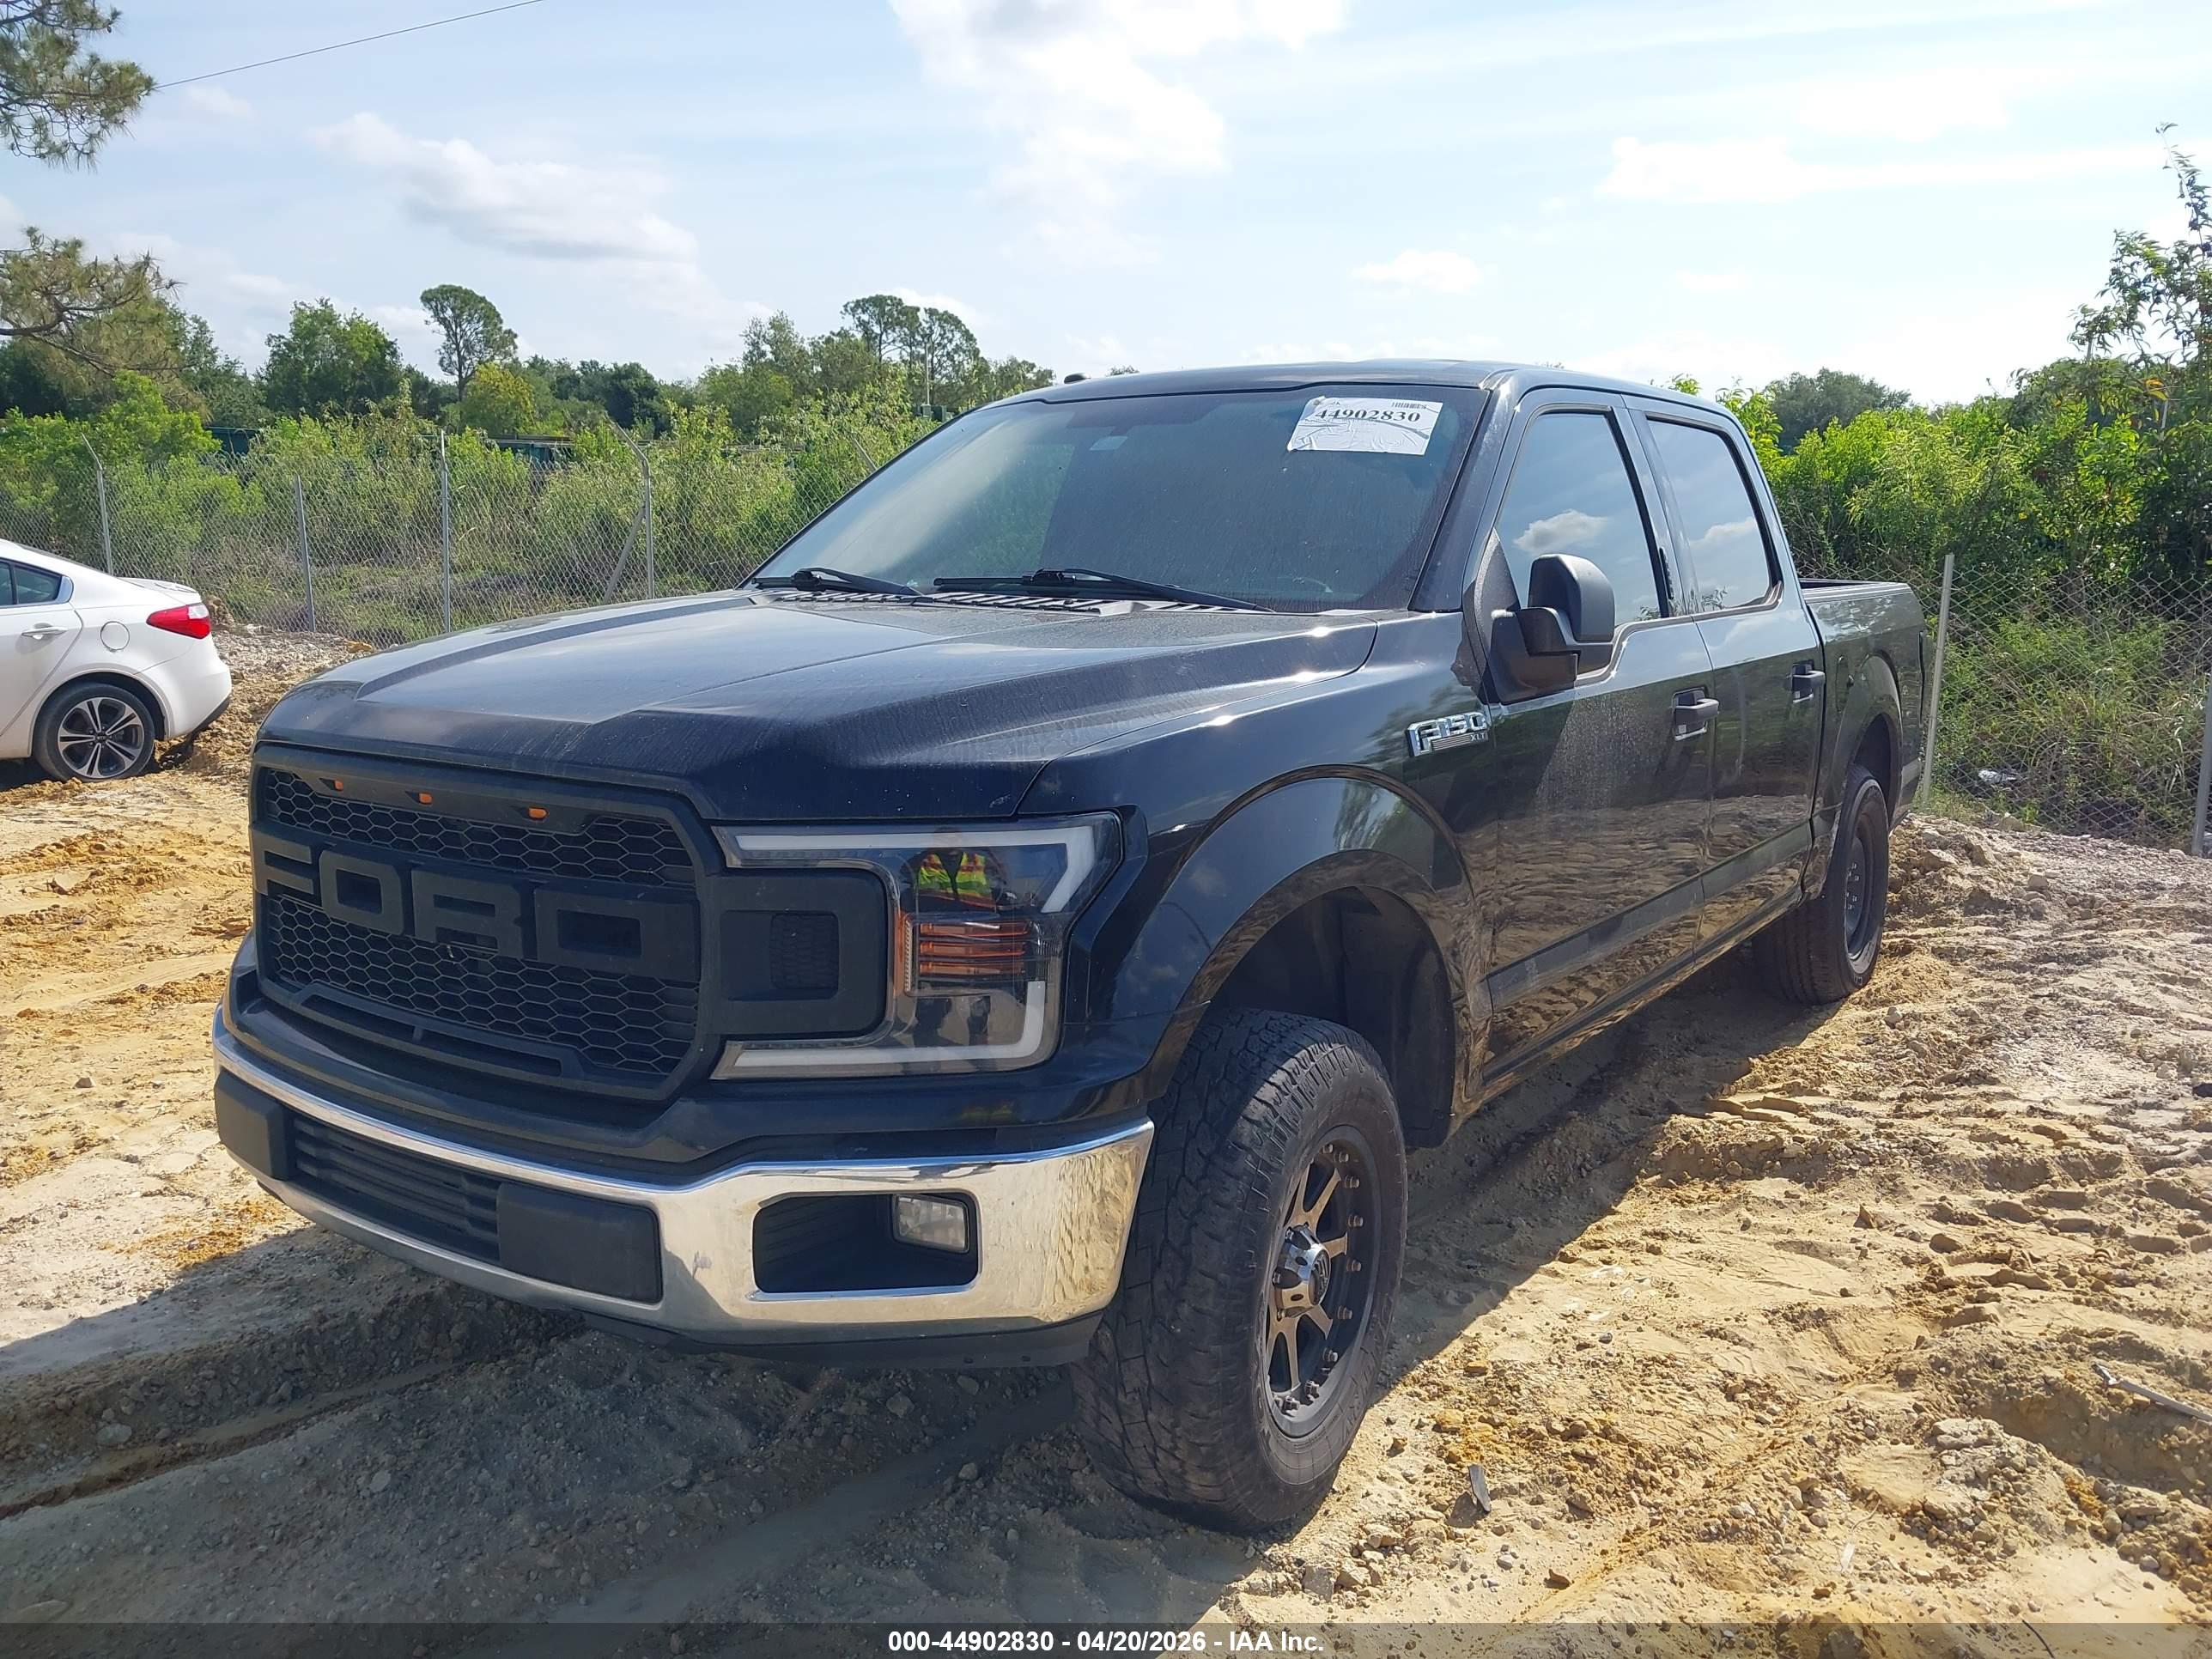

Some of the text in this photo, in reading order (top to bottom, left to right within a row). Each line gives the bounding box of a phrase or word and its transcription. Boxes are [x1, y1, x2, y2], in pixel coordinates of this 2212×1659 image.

[1315, 409, 1421, 422] 44902830
[1470, 732, 1486, 742] XLT
[252, 833, 701, 983] FORD
